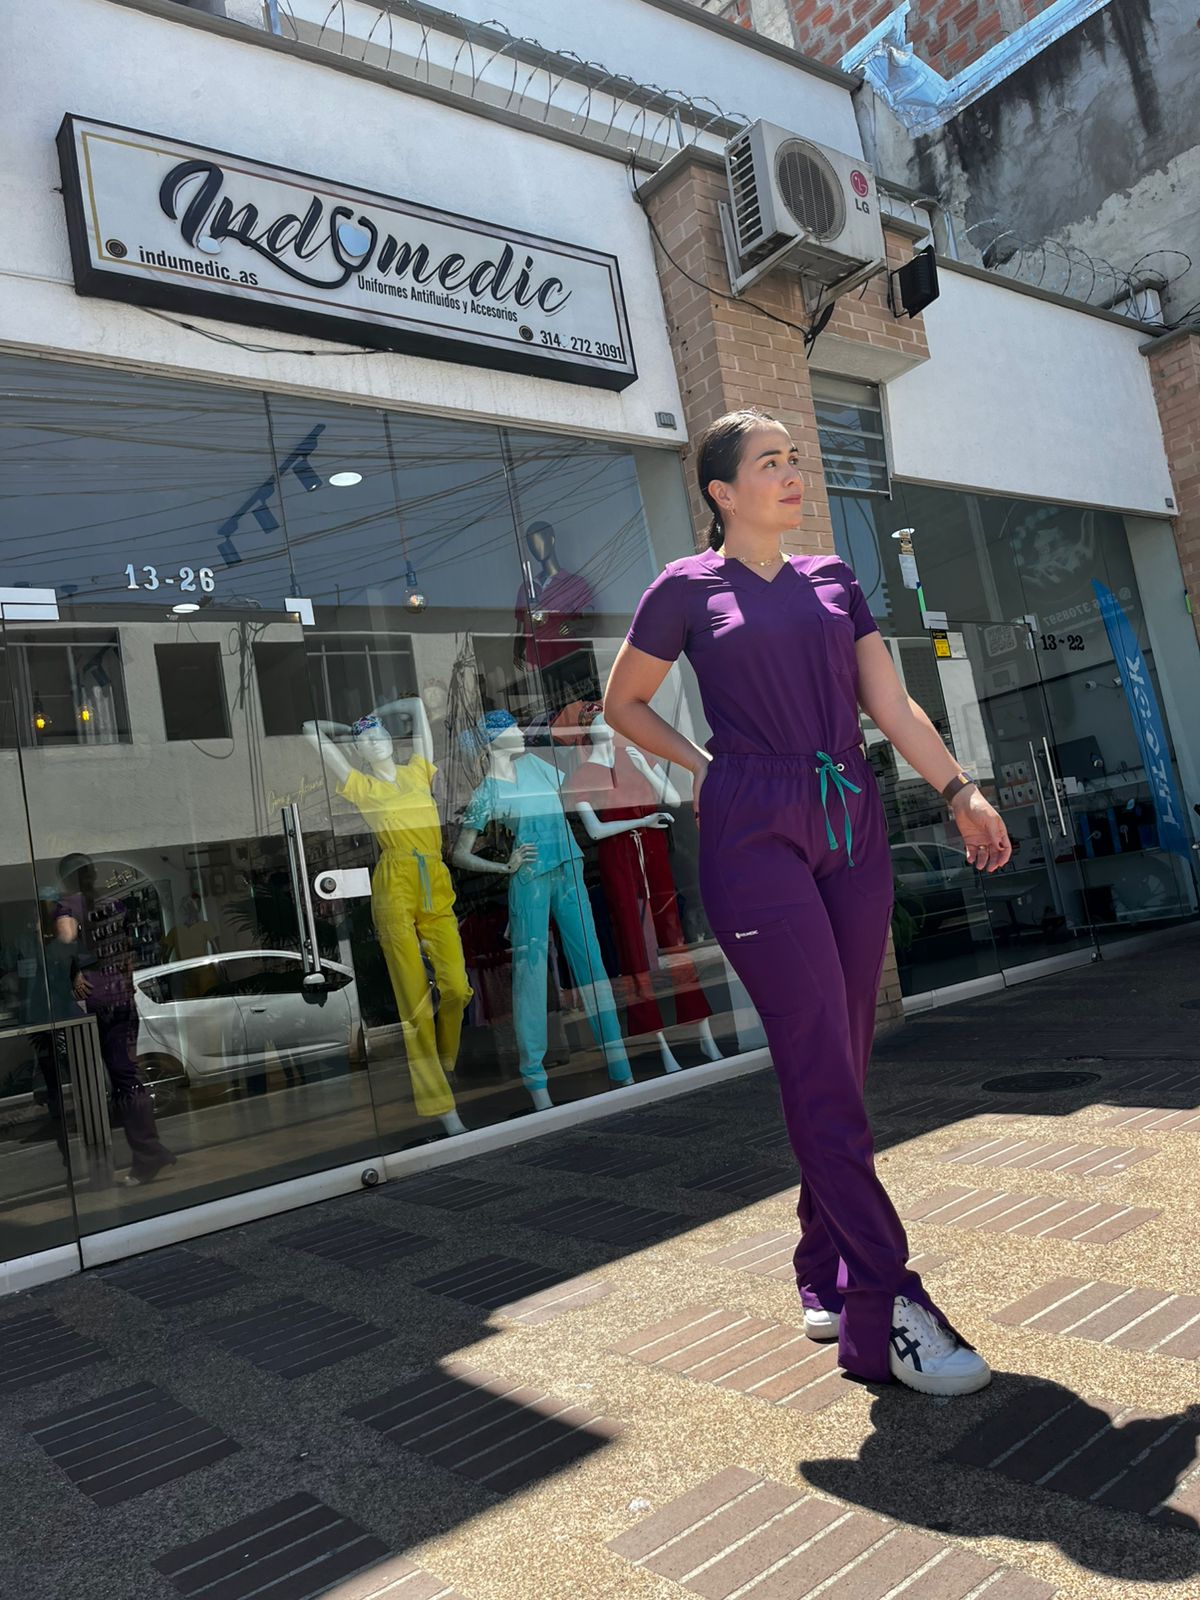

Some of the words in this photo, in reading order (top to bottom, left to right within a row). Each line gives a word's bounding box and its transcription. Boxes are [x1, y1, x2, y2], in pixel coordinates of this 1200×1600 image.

[855, 198, 870, 215] LG
[138, 245, 259, 286] indumedic_as
[357, 275, 409, 300] Uniformes
[410, 286, 461, 311] Antifluidos
[462, 302, 468, 314] y
[470, 299, 519, 323] Accesorios
[570, 336, 593, 354] 272
[595, 341, 623, 360] 3091
[125, 563, 215, 592] 13-26
